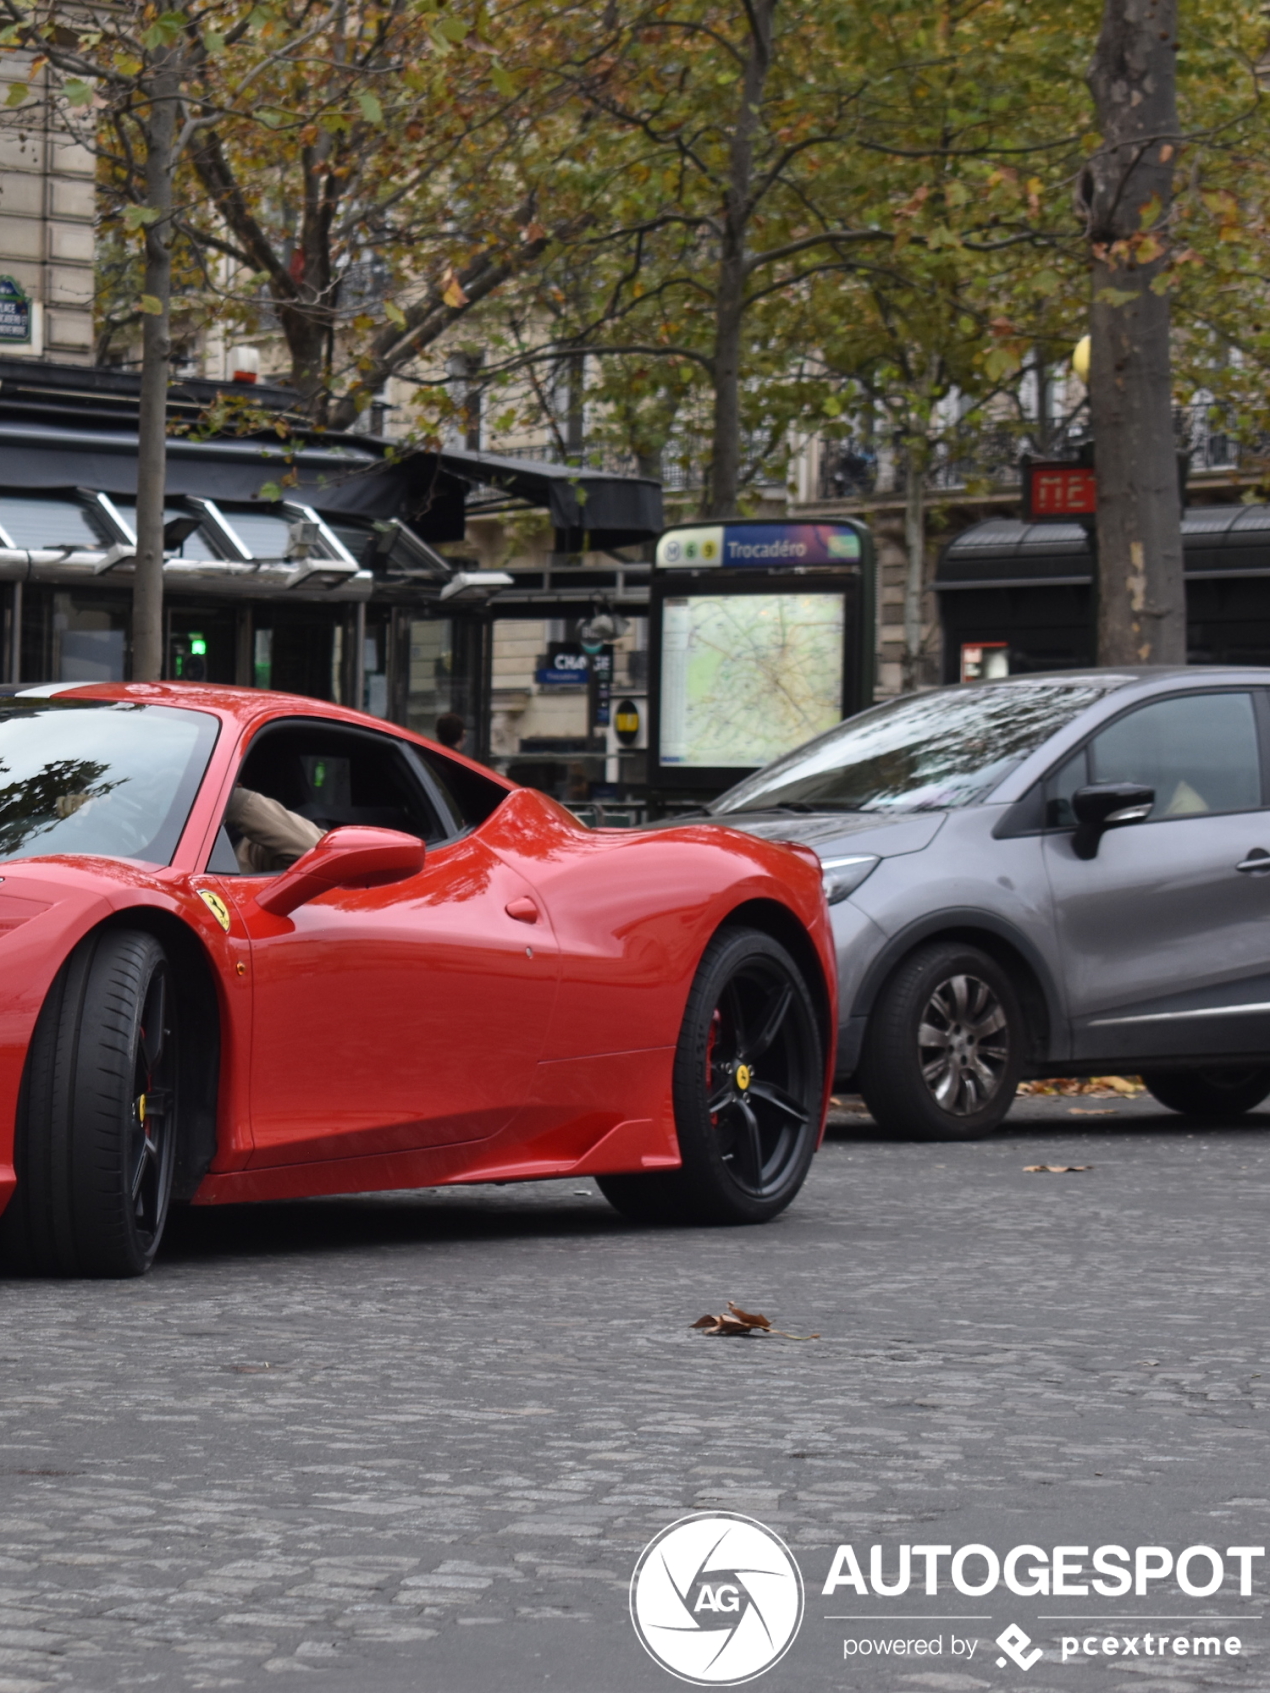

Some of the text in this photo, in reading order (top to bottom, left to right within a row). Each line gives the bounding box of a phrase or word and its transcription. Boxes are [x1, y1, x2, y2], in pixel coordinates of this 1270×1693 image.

[686, 544, 695, 558] 6
[704, 543, 713, 558] 9
[727, 539, 807, 559] Trocadéro
